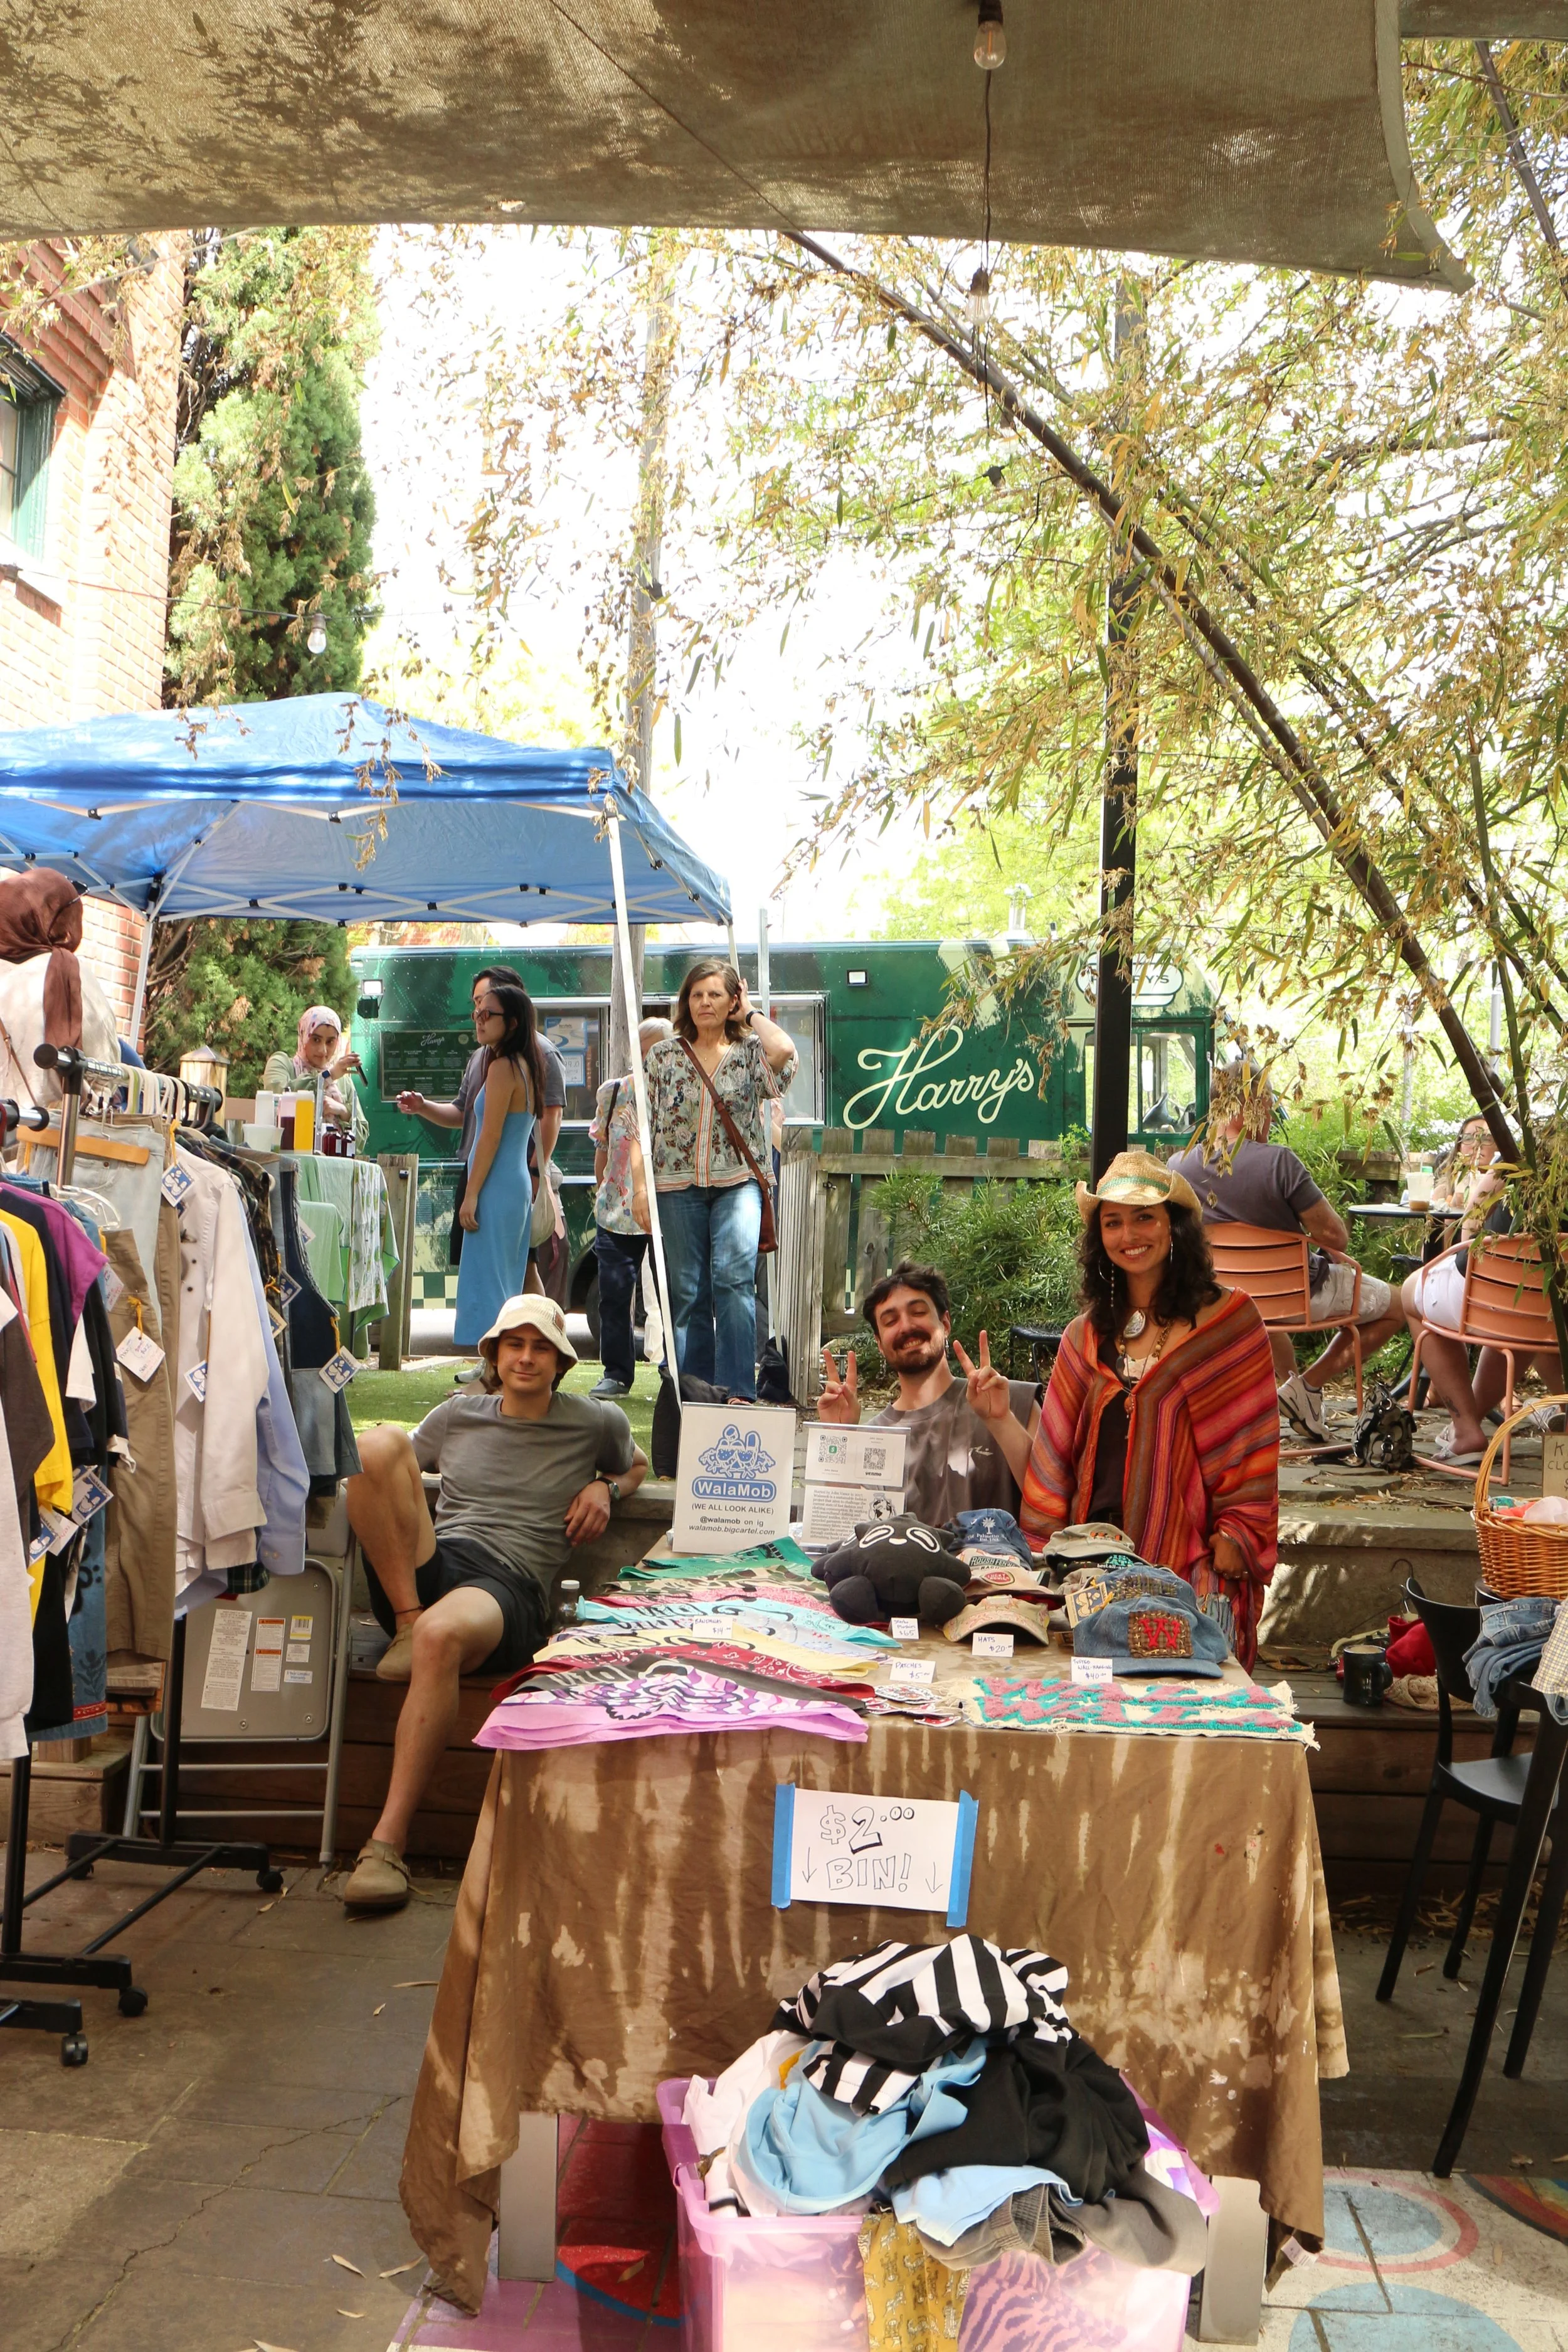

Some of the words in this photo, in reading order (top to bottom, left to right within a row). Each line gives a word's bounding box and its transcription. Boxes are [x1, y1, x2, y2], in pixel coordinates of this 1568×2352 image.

[843, 1025, 1034, 1130] Harry's
[697, 1481, 771, 1498] WalaMob
[748, 1507, 774, 1515] ALIKE)
[700, 1516, 741, 1525] @walamob
[757, 1519, 764, 1527] ig
[689, 1525, 775, 1536] walamob.bigcartel.com
[971, 1556, 994, 1565] ROUSH
[1139, 1618, 1180, 1648] W
[826, 1853, 911, 1893] BIN!
